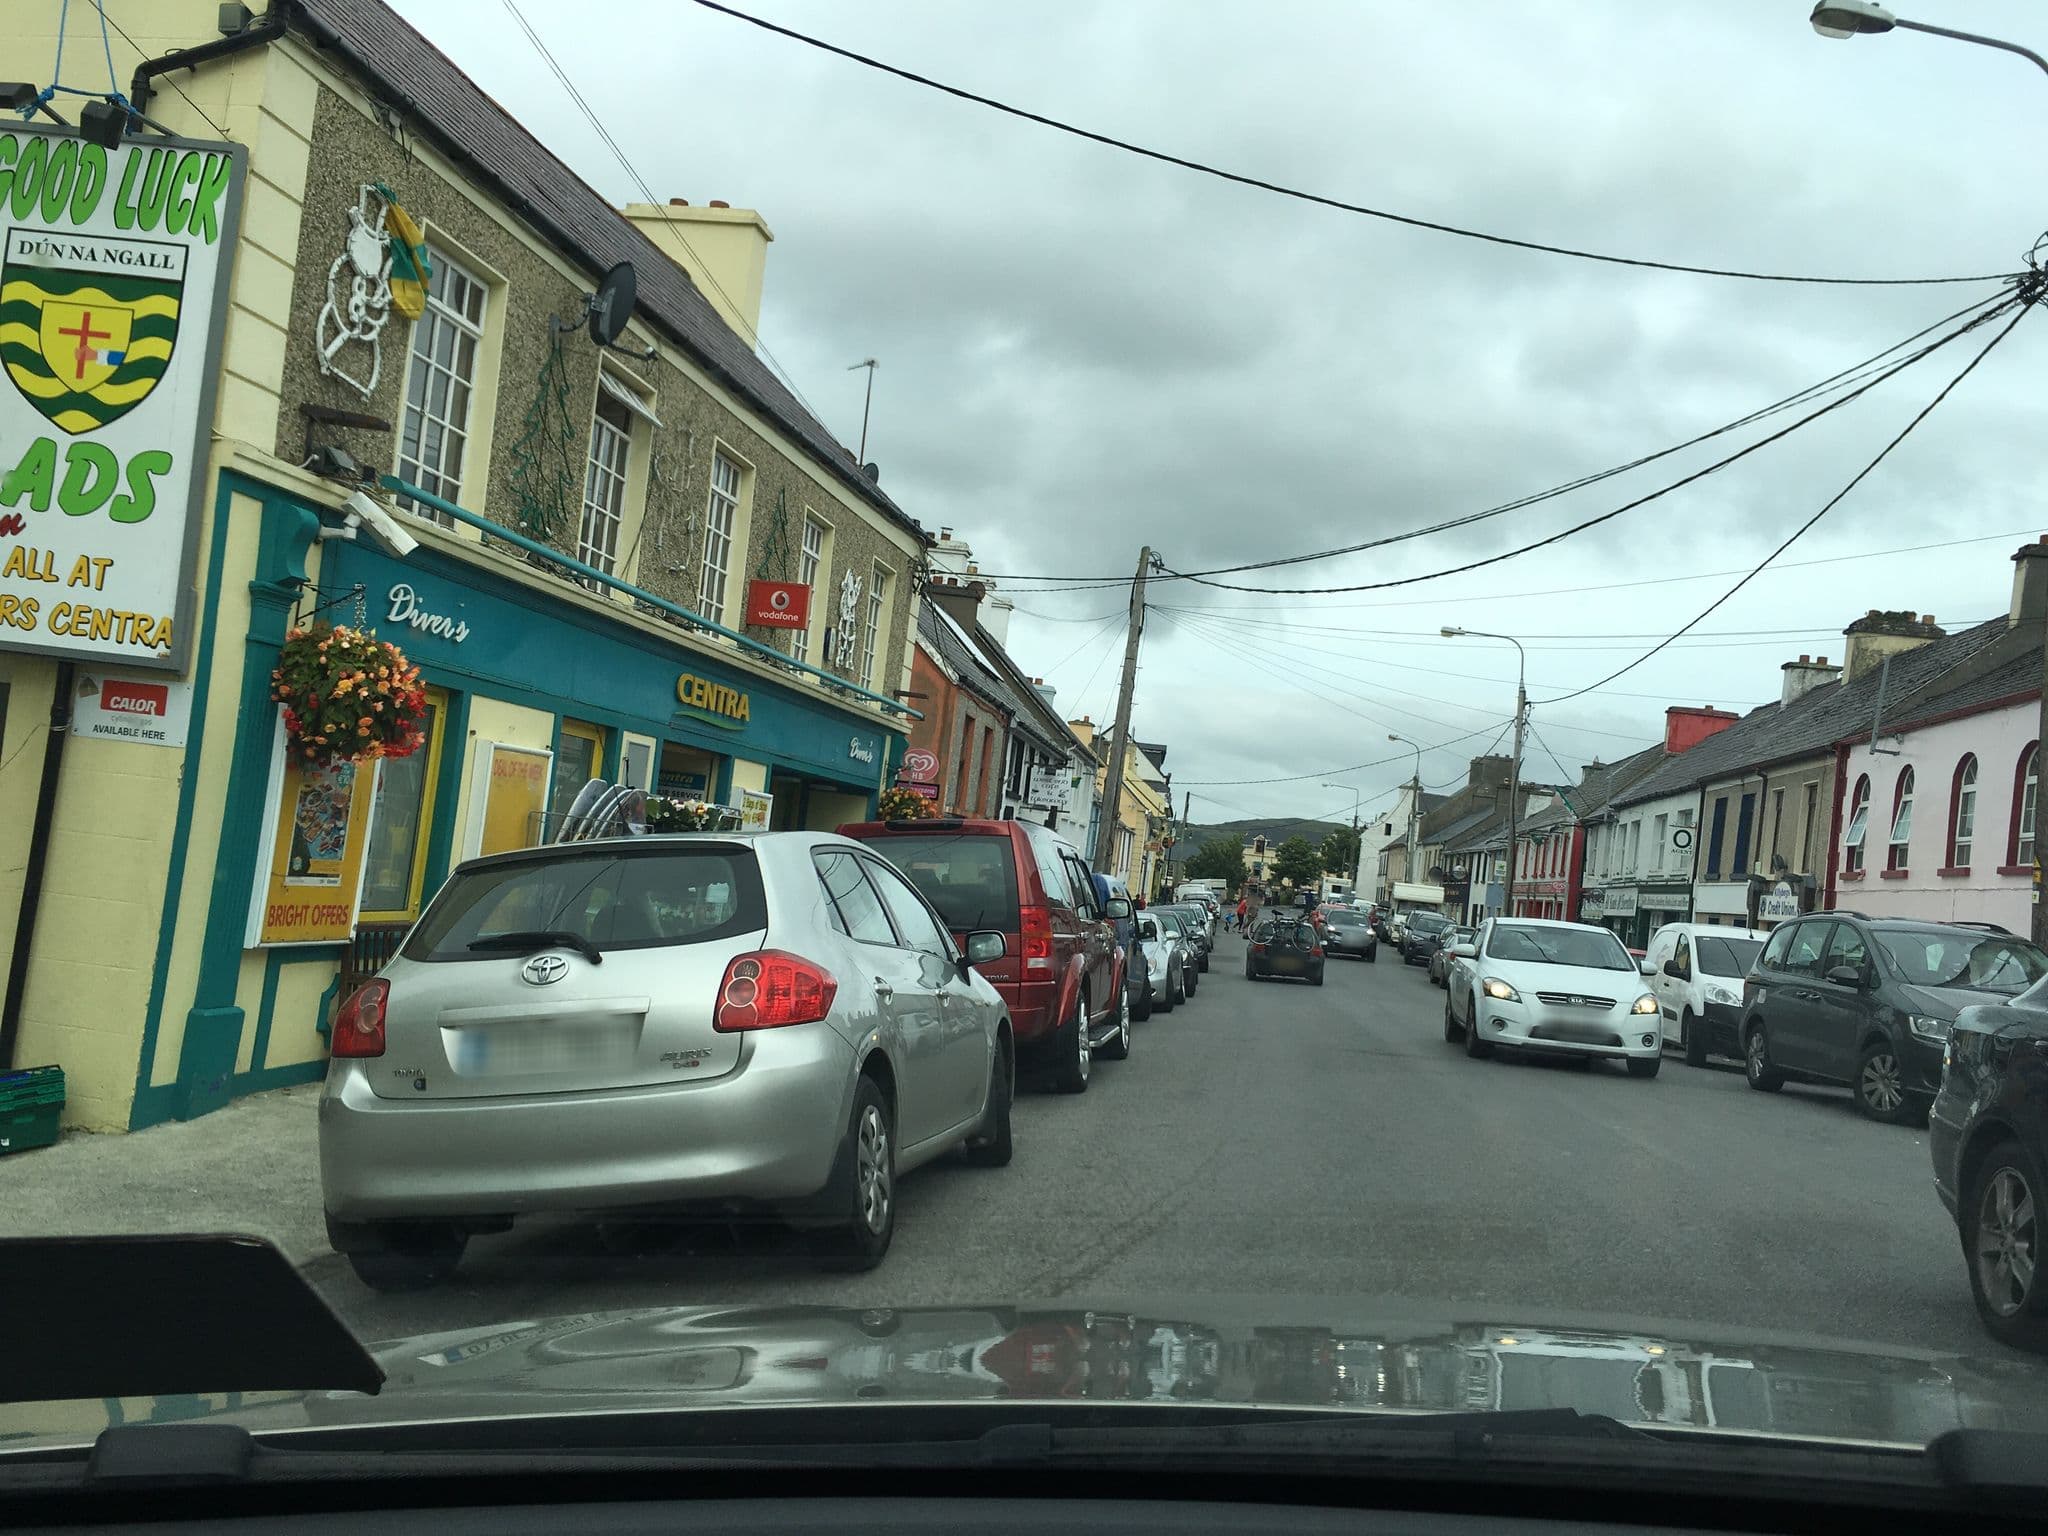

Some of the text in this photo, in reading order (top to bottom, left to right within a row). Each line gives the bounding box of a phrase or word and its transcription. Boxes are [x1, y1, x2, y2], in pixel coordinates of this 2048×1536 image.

[114, 147, 232, 245] LUCK
[19, 239, 175, 269] DÚN NA NGALL
[3, 546, 113, 590] ALL AT
[48, 602, 173, 649] CENTRA
[758, 610, 799, 622] vodafone
[110, 696, 157, 715] CALOR
[677, 672, 750, 721] CENTRA
[92, 724, 165, 740] AVAILABLE HERE
[912, 772, 924, 780] HB
[671, 790, 703, 801] SERVICE
[268, 904, 348, 927] BRIGHT OFFERS
[1767, 900, 1794, 916] Credit Union
[660, 1047, 712, 1061] AURIS
